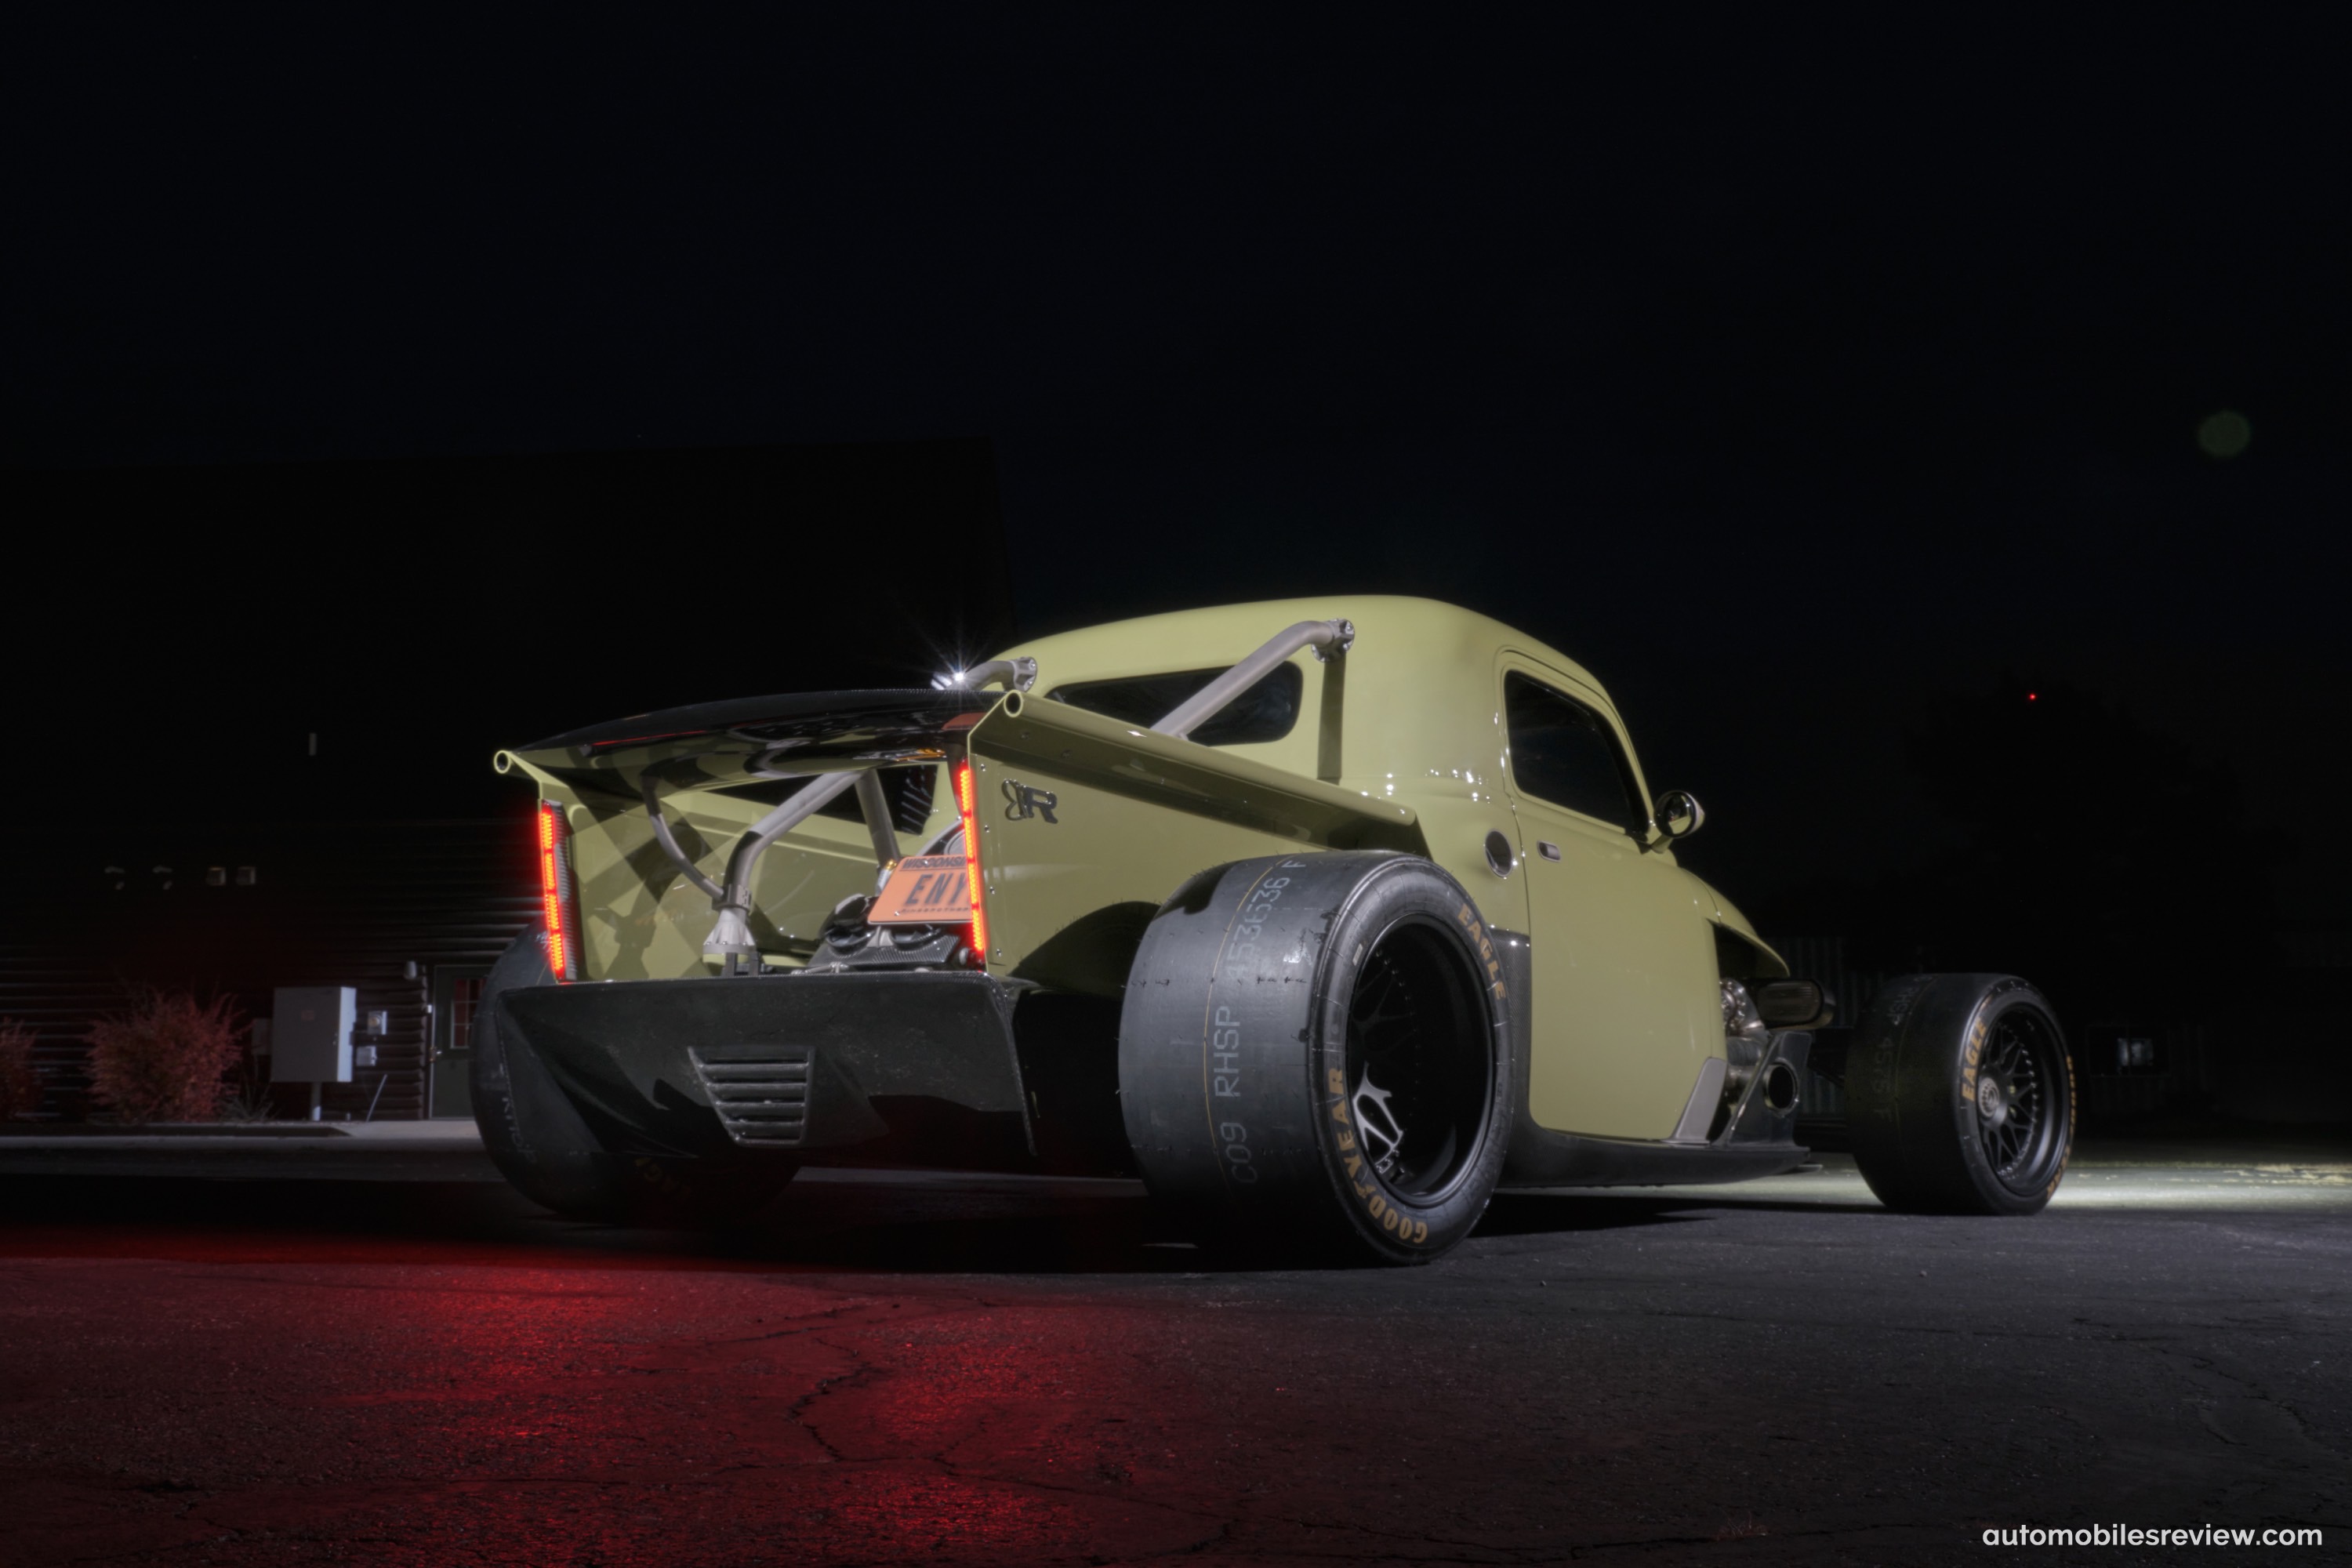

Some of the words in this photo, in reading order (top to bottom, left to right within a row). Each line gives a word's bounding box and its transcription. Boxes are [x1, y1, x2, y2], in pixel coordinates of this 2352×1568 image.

[902, 856, 967, 869] WISCONSI
[904, 872, 967, 905] ENY
[1457, 902, 1506, 1000] EAGLE
[1214, 1005, 1242, 1098] RHSP
[1961, 1017, 1987, 1102] EAGLE
[1328, 1068, 1428, 1243] GOODYEAR
